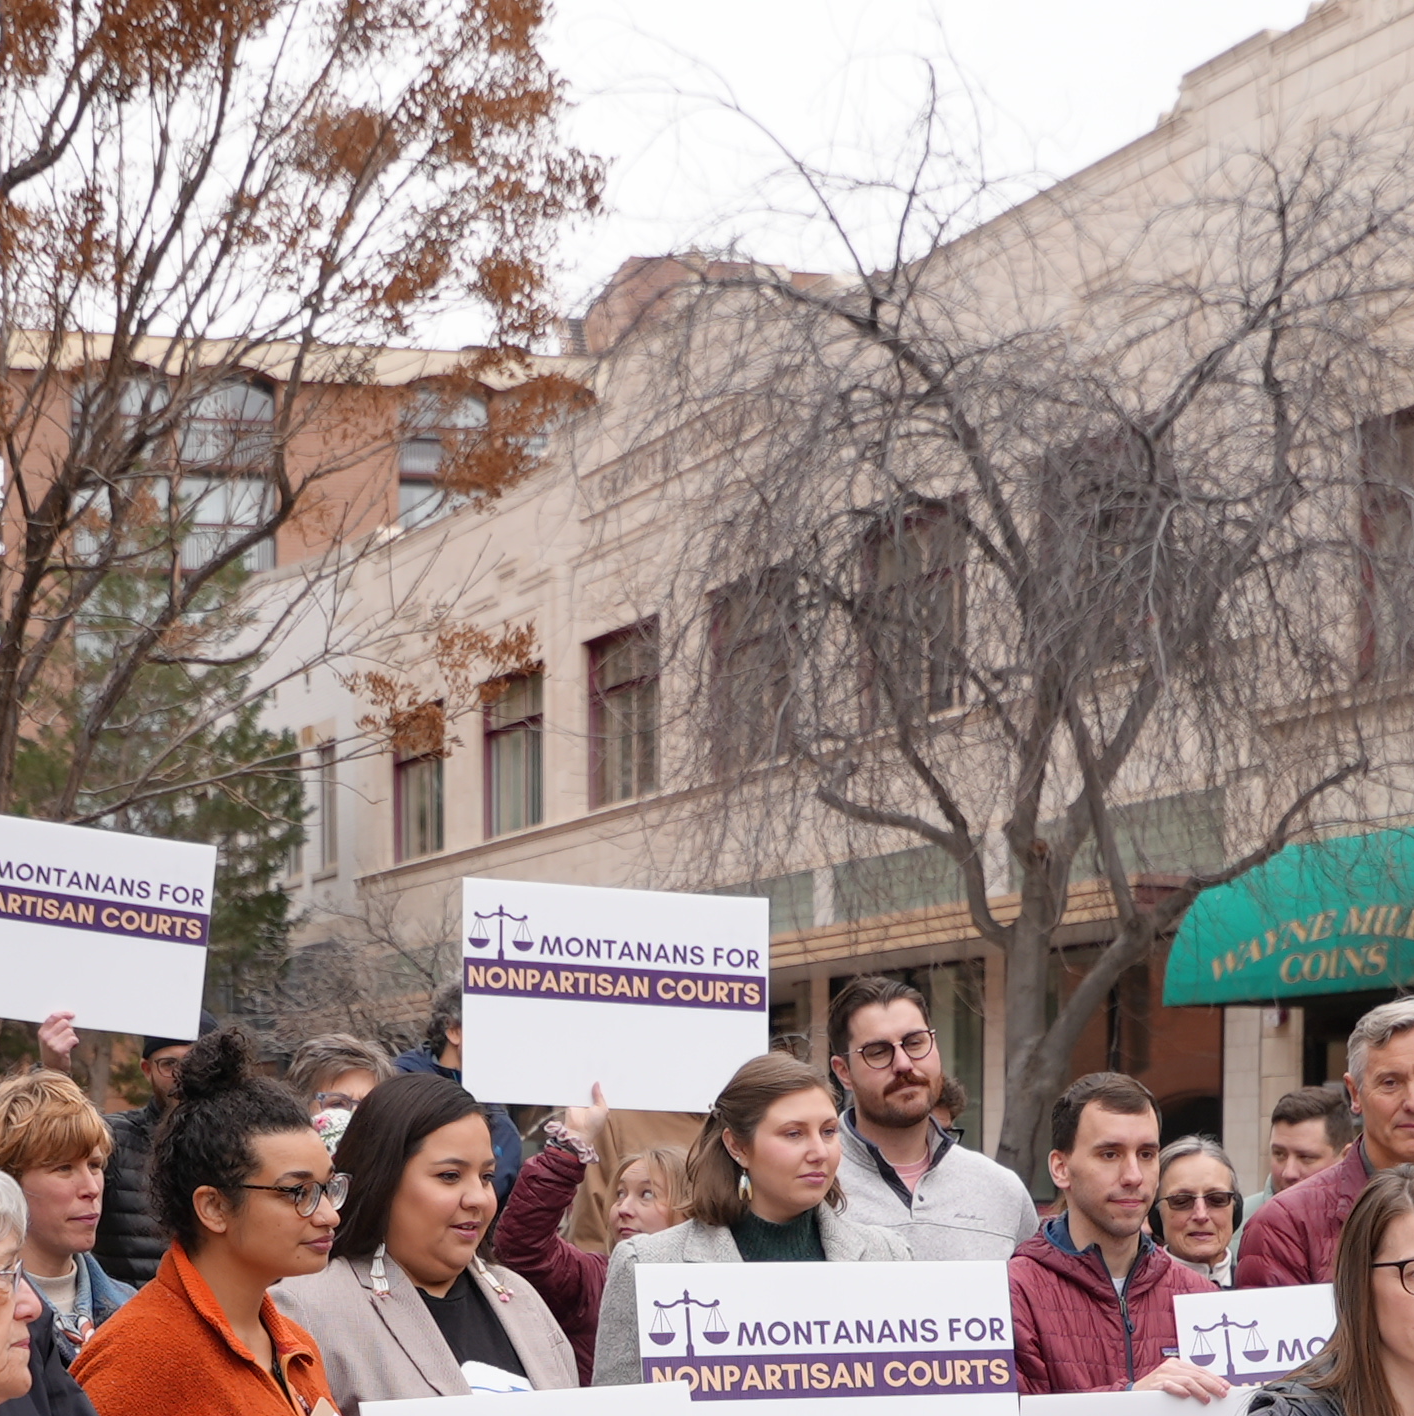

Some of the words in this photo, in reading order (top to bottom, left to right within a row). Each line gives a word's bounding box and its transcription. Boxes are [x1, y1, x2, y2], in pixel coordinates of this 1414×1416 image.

[158, 883, 205, 908] FOR
[100, 907, 202, 940] COURTS
[539, 935, 705, 966] MONTANANS
[713, 947, 760, 969] FOR
[1211, 908, 1338, 982] WAYNE
[1279, 942, 1389, 984] COINS
[468, 964, 650, 998] NONPARTISAN
[656, 977, 761, 1005] COURTS
[737, 1318, 939, 1347] MONTANANS
[948, 1317, 1007, 1342] FOR
[883, 1358, 1010, 1388] COURTS
